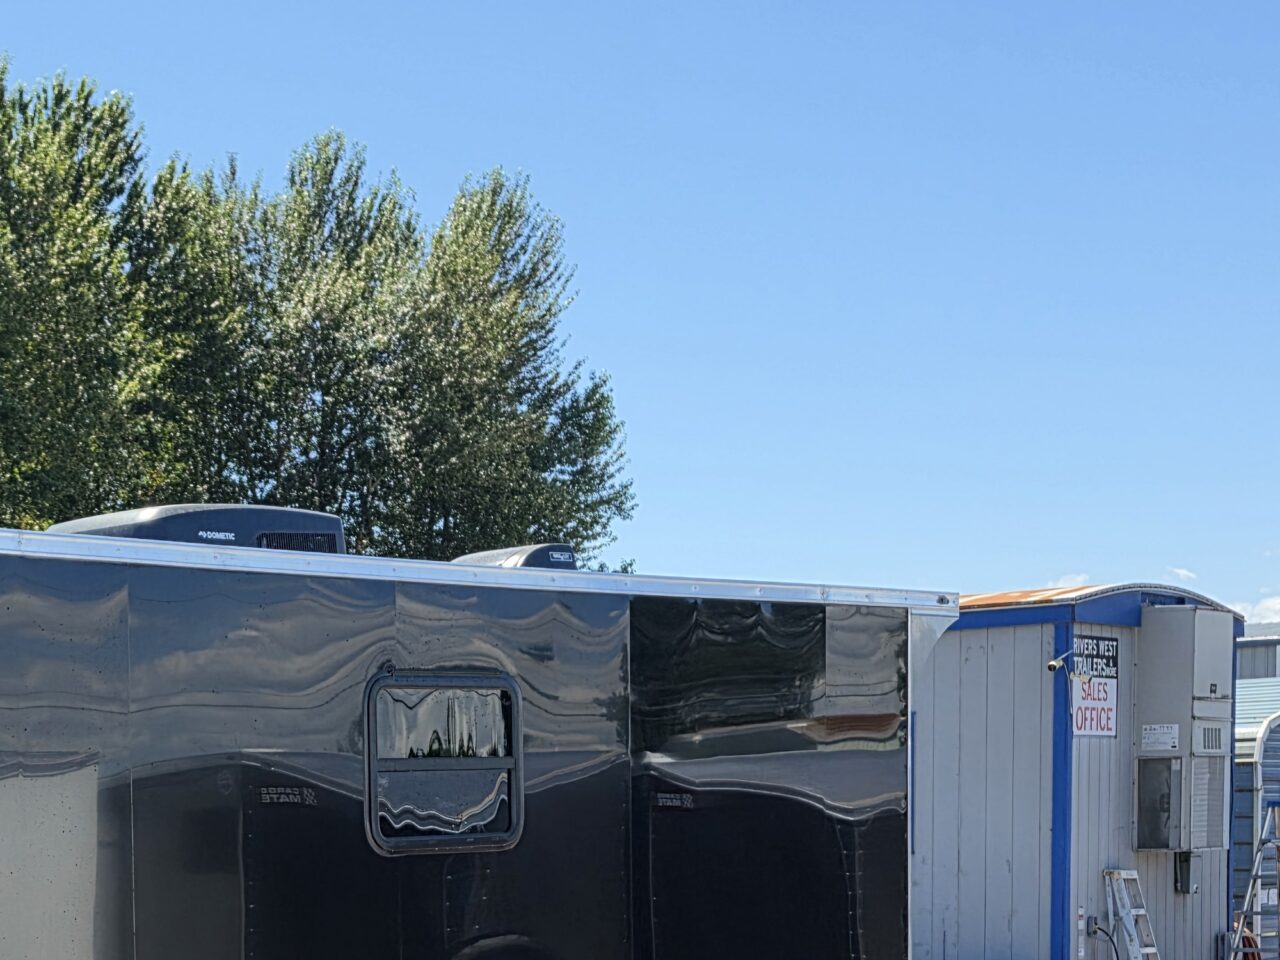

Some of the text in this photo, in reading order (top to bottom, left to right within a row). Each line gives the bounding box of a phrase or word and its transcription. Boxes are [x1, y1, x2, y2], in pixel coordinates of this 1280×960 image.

[207, 531, 236, 541] DOMETIC
[1073, 638, 1117, 656] RIVERS WEST
[1074, 656, 1107, 676] TRAILERS
[1081, 681, 1108, 701] SALES
[1075, 706, 1113, 732] OFFICE
